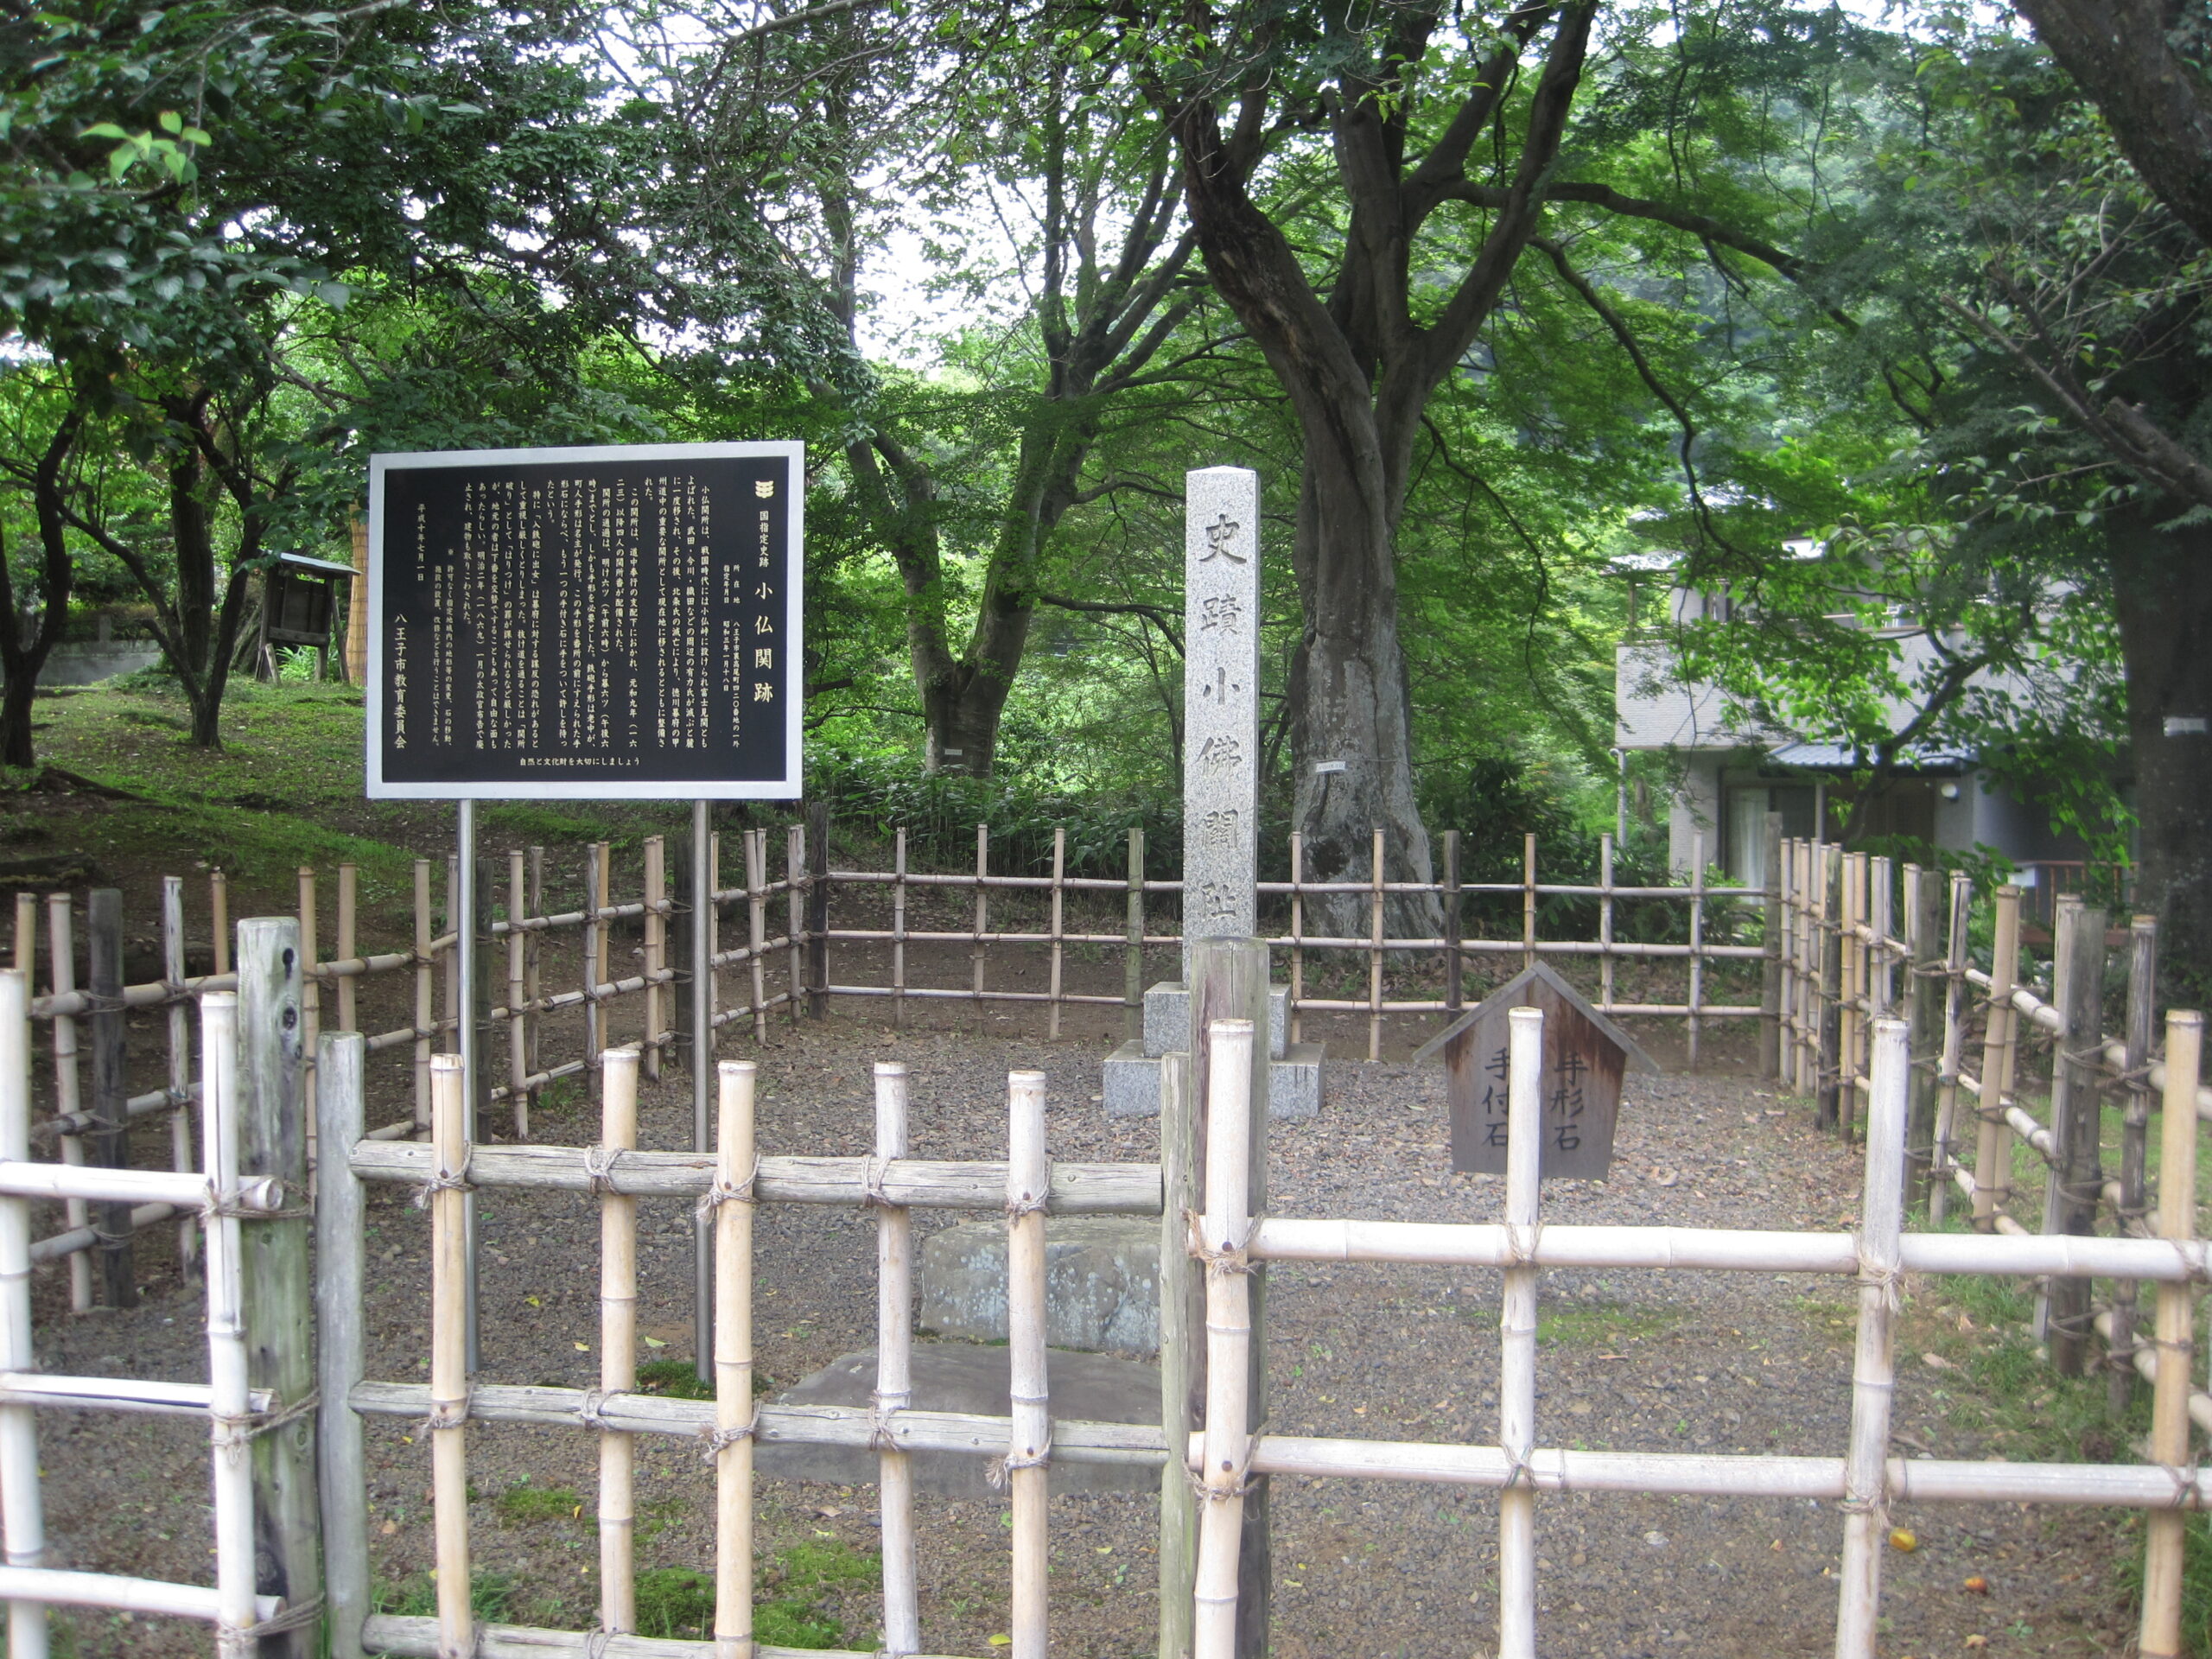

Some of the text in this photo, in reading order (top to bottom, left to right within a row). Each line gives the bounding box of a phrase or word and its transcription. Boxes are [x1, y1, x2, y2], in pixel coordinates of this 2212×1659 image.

[546, 479, 556, 524] たという。
[644, 477, 653, 501] れた。
[416, 504, 426, 582] 平成十年七月一日
[753, 510, 773, 703] 国指定史跡 小仏関跡
[393, 613, 408, 749] 八王子市教育委員会
[721, 620, 730, 692] 昭和三年一月十八日
[519, 756, 639, 766] 自然と文化財を大切にしましょう
[1550, 1052, 1588, 1151] 手形石
